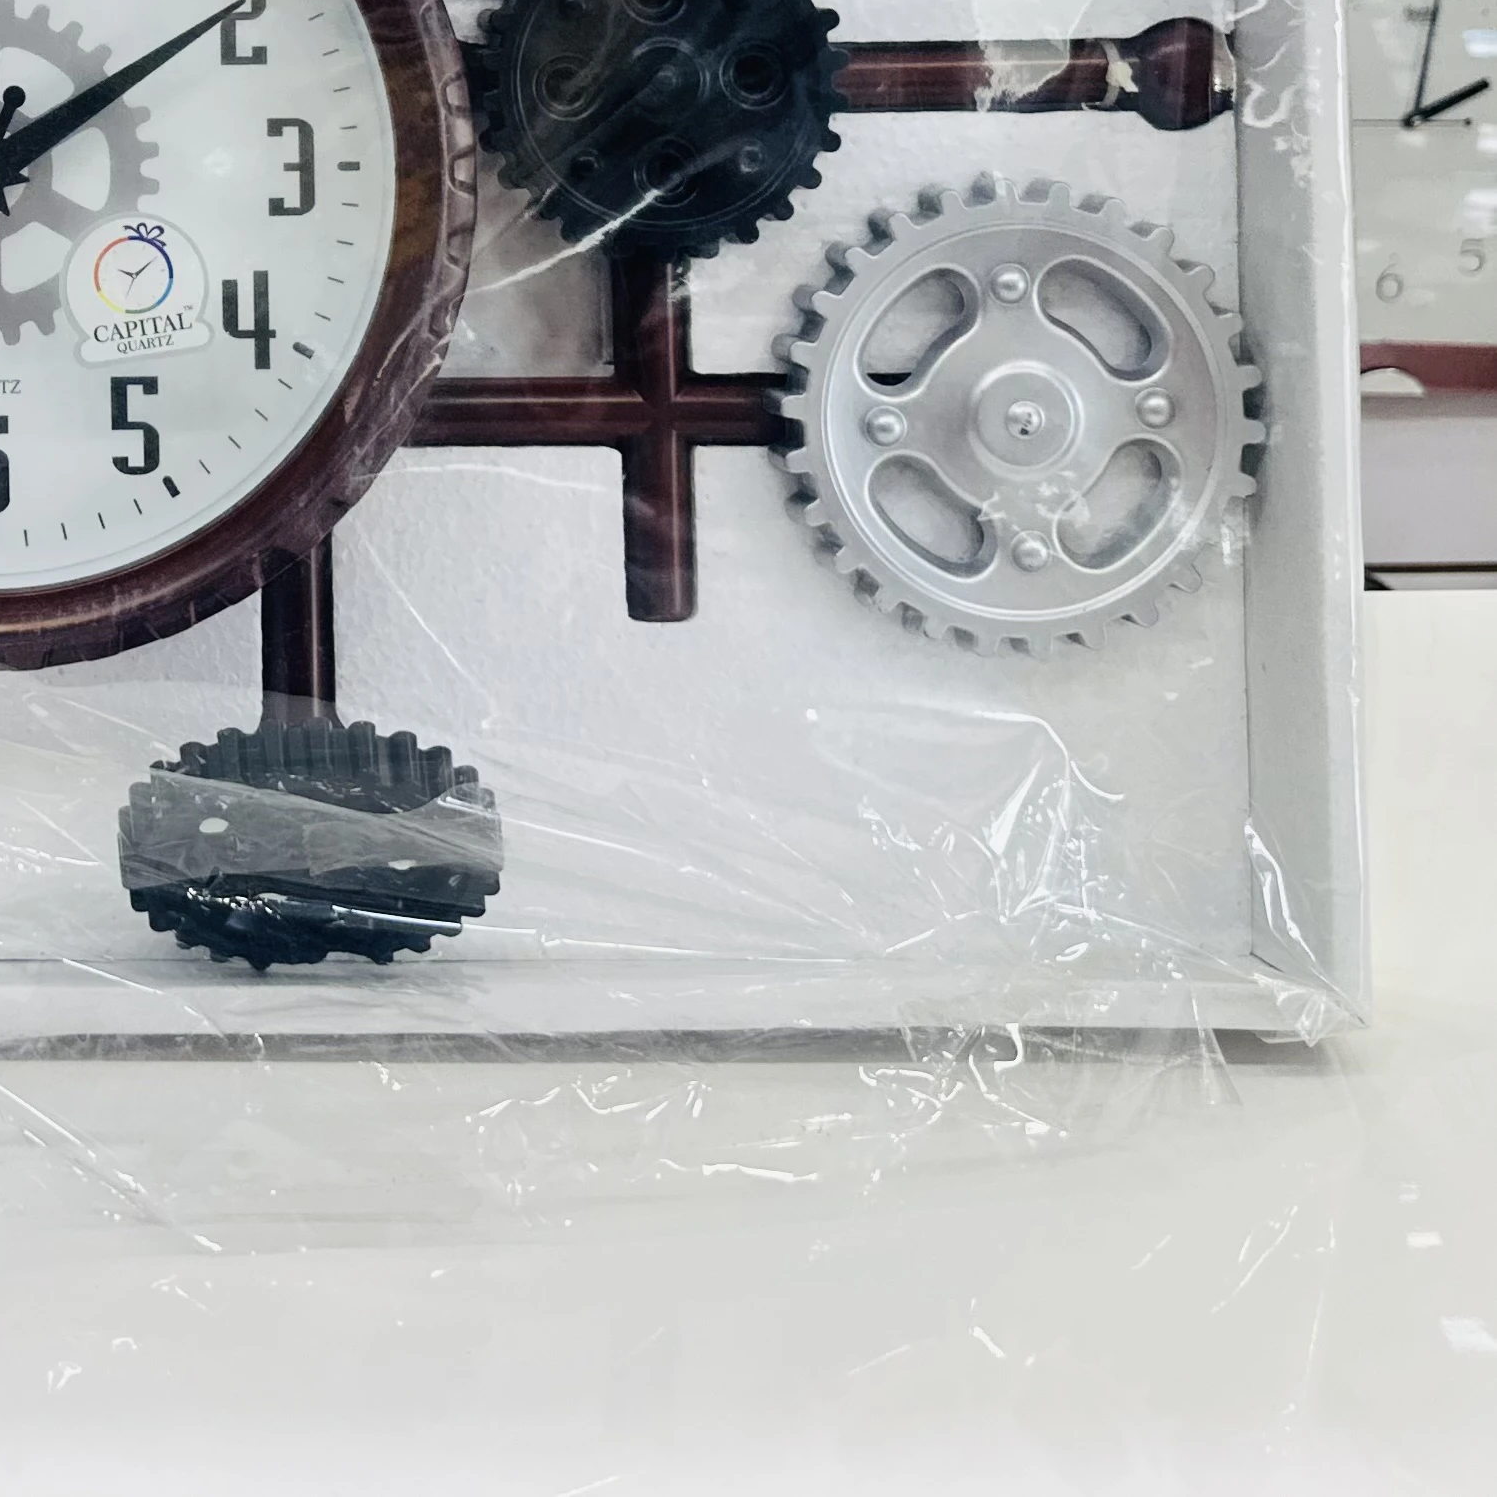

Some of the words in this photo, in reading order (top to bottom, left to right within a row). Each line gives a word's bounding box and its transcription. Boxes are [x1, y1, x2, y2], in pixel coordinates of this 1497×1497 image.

[267, 117, 315, 216] 3
[1375, 252, 1402, 302] 6
[1457, 238, 1486, 275] 5
[93, 313, 193, 344] CAPITAL
[116, 335, 175, 354] QUARTZ
[222, 270, 276, 370] 4
[110, 376, 160, 475] 5
